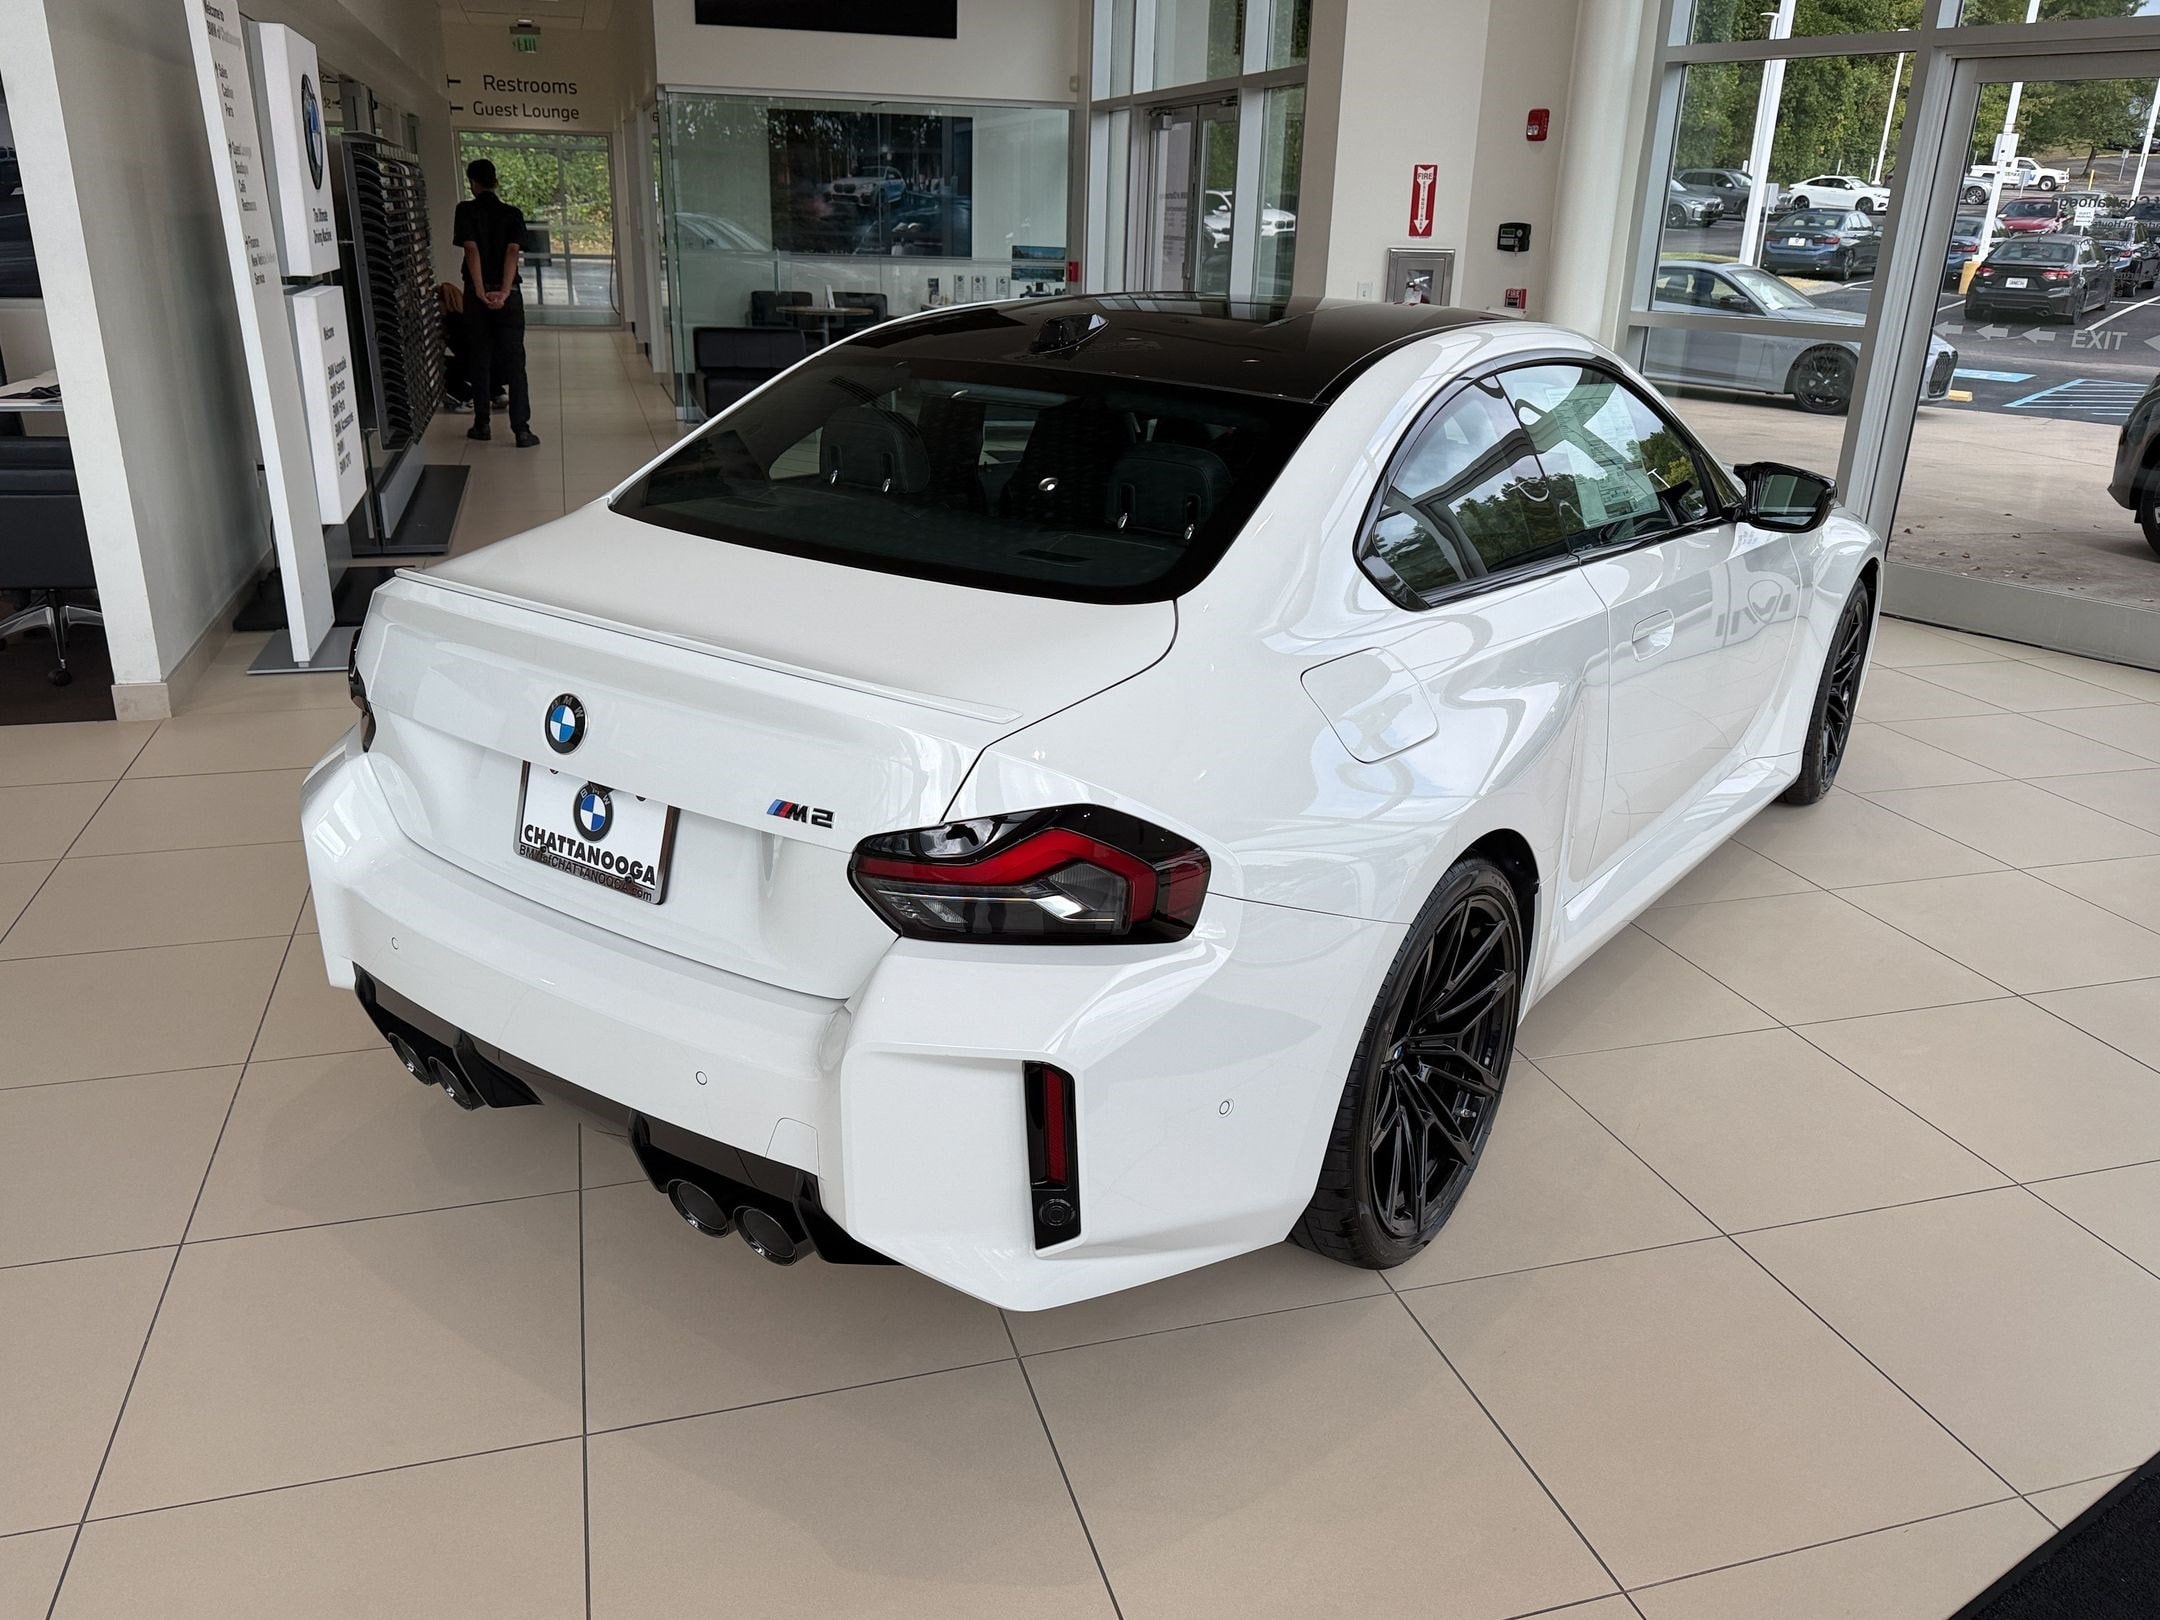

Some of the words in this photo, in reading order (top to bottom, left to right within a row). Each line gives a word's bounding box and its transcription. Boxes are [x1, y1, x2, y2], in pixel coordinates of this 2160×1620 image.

[483, 74, 578, 95] Restrooms
[473, 100, 519, 118] Guest
[522, 103, 580, 122] Lounge
[1417, 172, 1433, 180] FIRE
[2071, 329, 2128, 350] EXIT
[551, 695, 584, 719] BMW
[785, 802, 835, 829] M2
[524, 824, 656, 886] CHATTANOOGA
